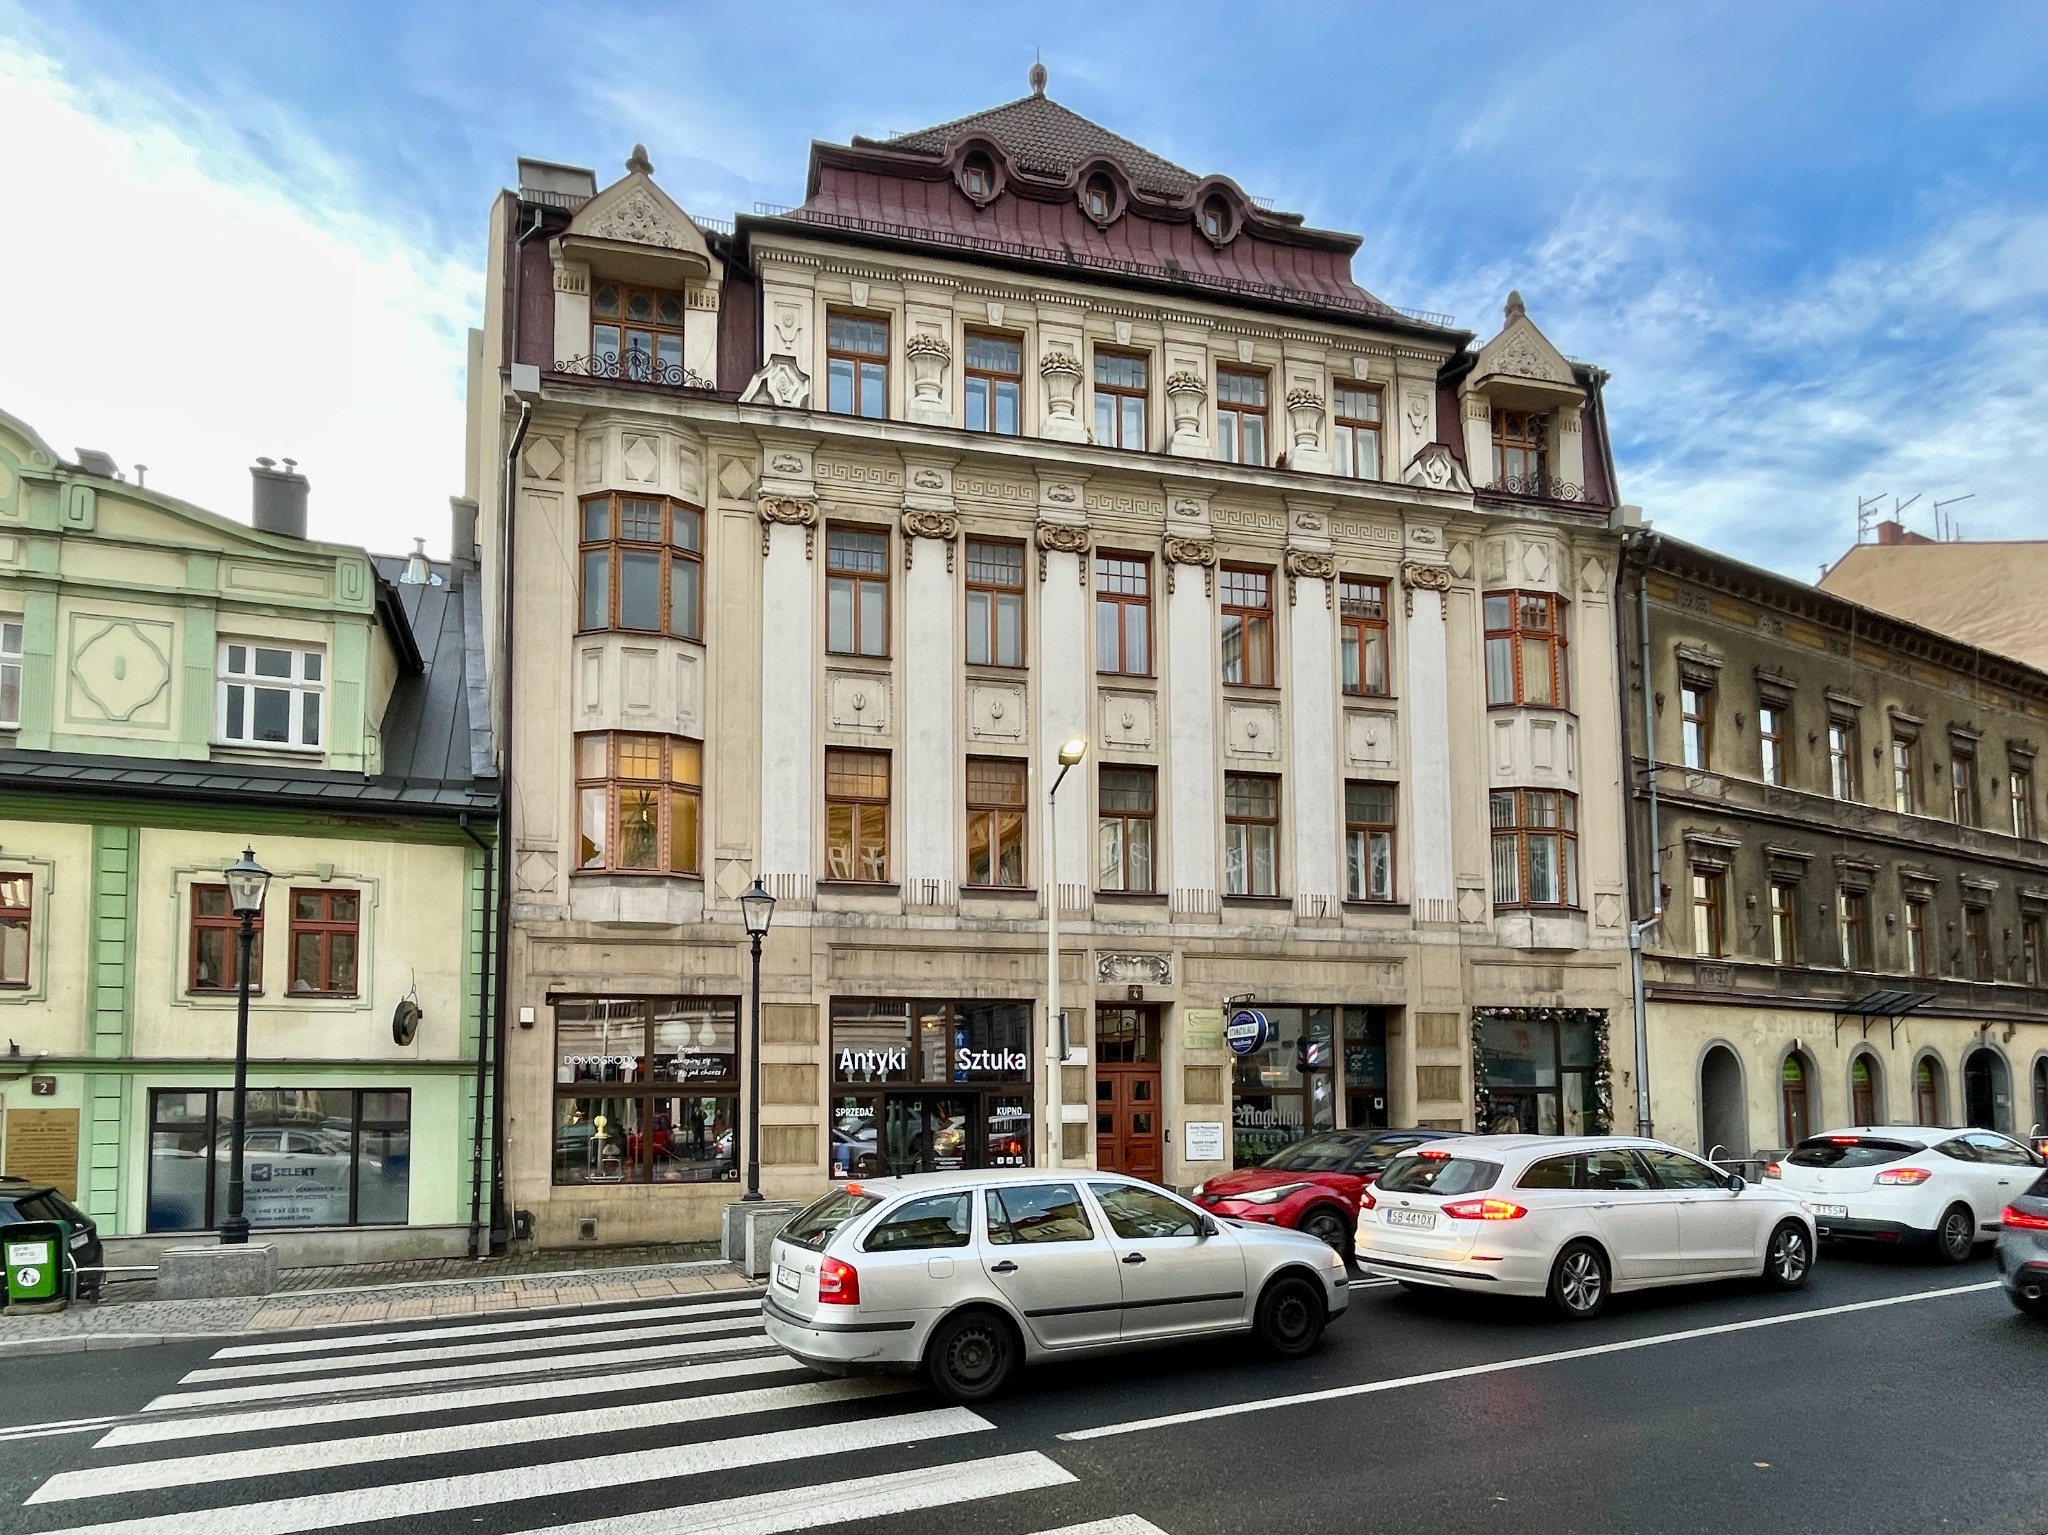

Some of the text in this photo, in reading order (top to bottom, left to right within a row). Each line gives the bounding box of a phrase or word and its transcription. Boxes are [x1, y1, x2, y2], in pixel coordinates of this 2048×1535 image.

[1132, 990, 1139, 999] 4
[564, 1055, 637, 1066] DOMOGRODY
[839, 1046, 906, 1075] Antyki
[958, 1047, 1027, 1071] Sztuka
[39, 1083, 48, 1093] 2
[835, 1107, 875, 1117] SPRZEDAŻ
[996, 1106, 1023, 1116] KUPNO
[273, 1167, 317, 1177] SELEKT
[1392, 1211, 1433, 1226] SB 4410X
